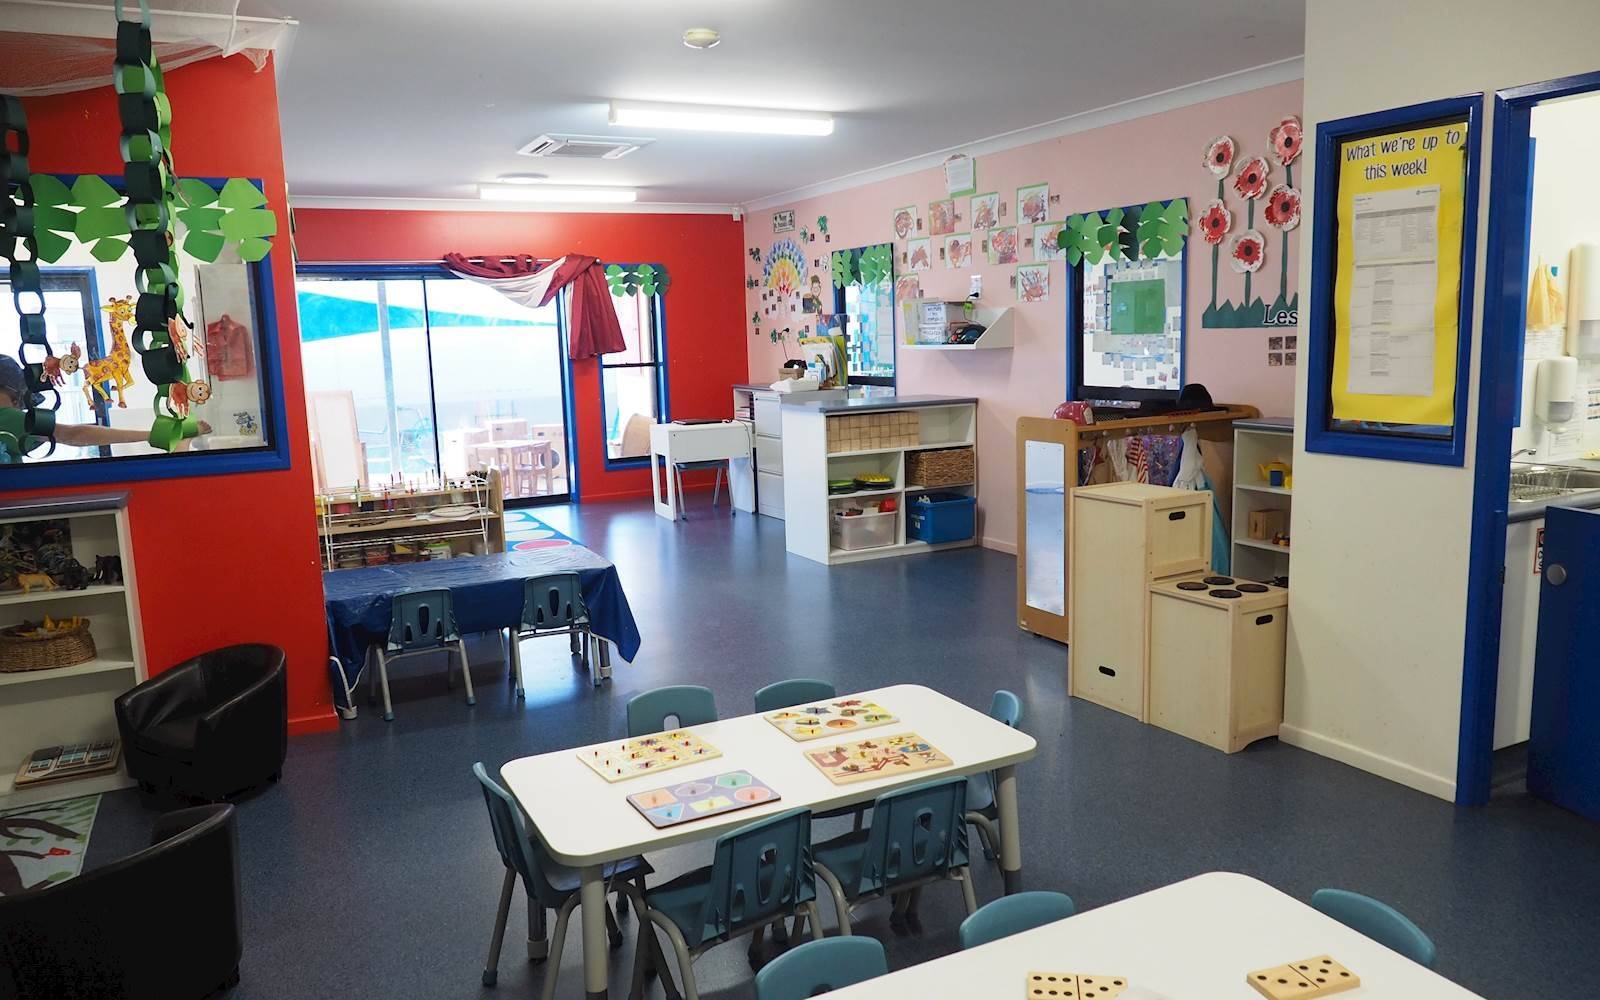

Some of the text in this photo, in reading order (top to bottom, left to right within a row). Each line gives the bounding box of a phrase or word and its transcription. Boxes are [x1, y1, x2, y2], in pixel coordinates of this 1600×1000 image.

[1346, 129, 1460, 162] What we're up to
[1364, 158, 1428, 181] this week!
